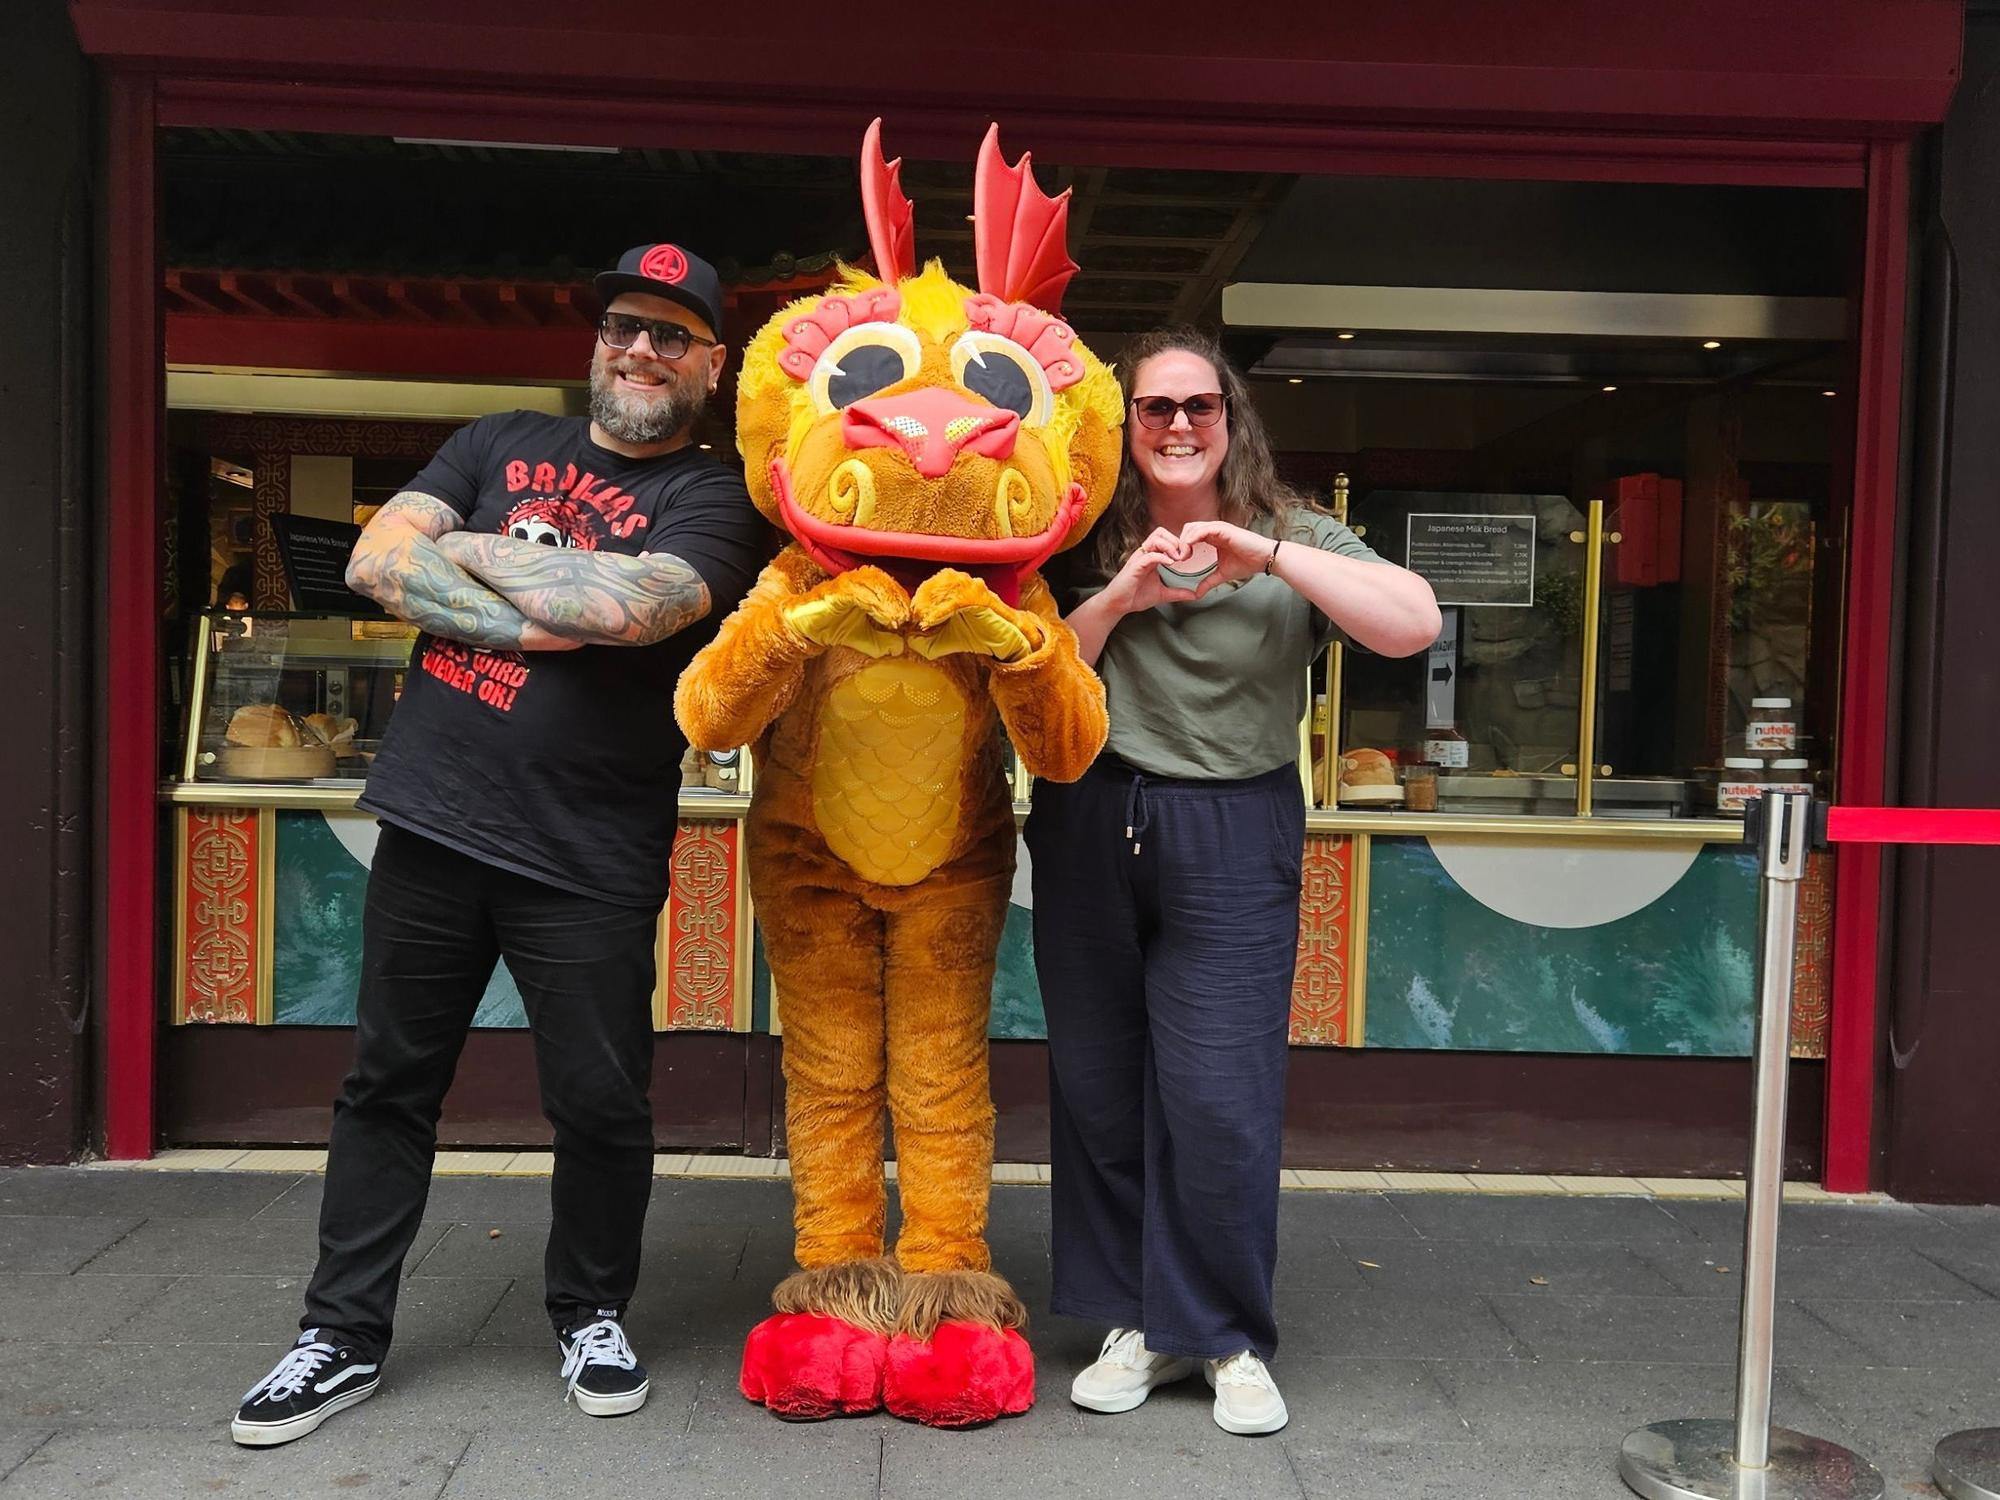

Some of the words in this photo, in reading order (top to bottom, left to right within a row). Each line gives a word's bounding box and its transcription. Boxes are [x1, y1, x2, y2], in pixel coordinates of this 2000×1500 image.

[1428, 524, 1464, 533] Japanese
[1466, 524, 1482, 533] Milk
[1484, 525, 1507, 534] Bread
[473, 653, 527, 688] WIRD
[422, 650, 477, 694] WIEDER
[478, 679, 517, 712] OK!
[1755, 724, 1796, 735] nutella
[1721, 784, 1762, 796] nutella
